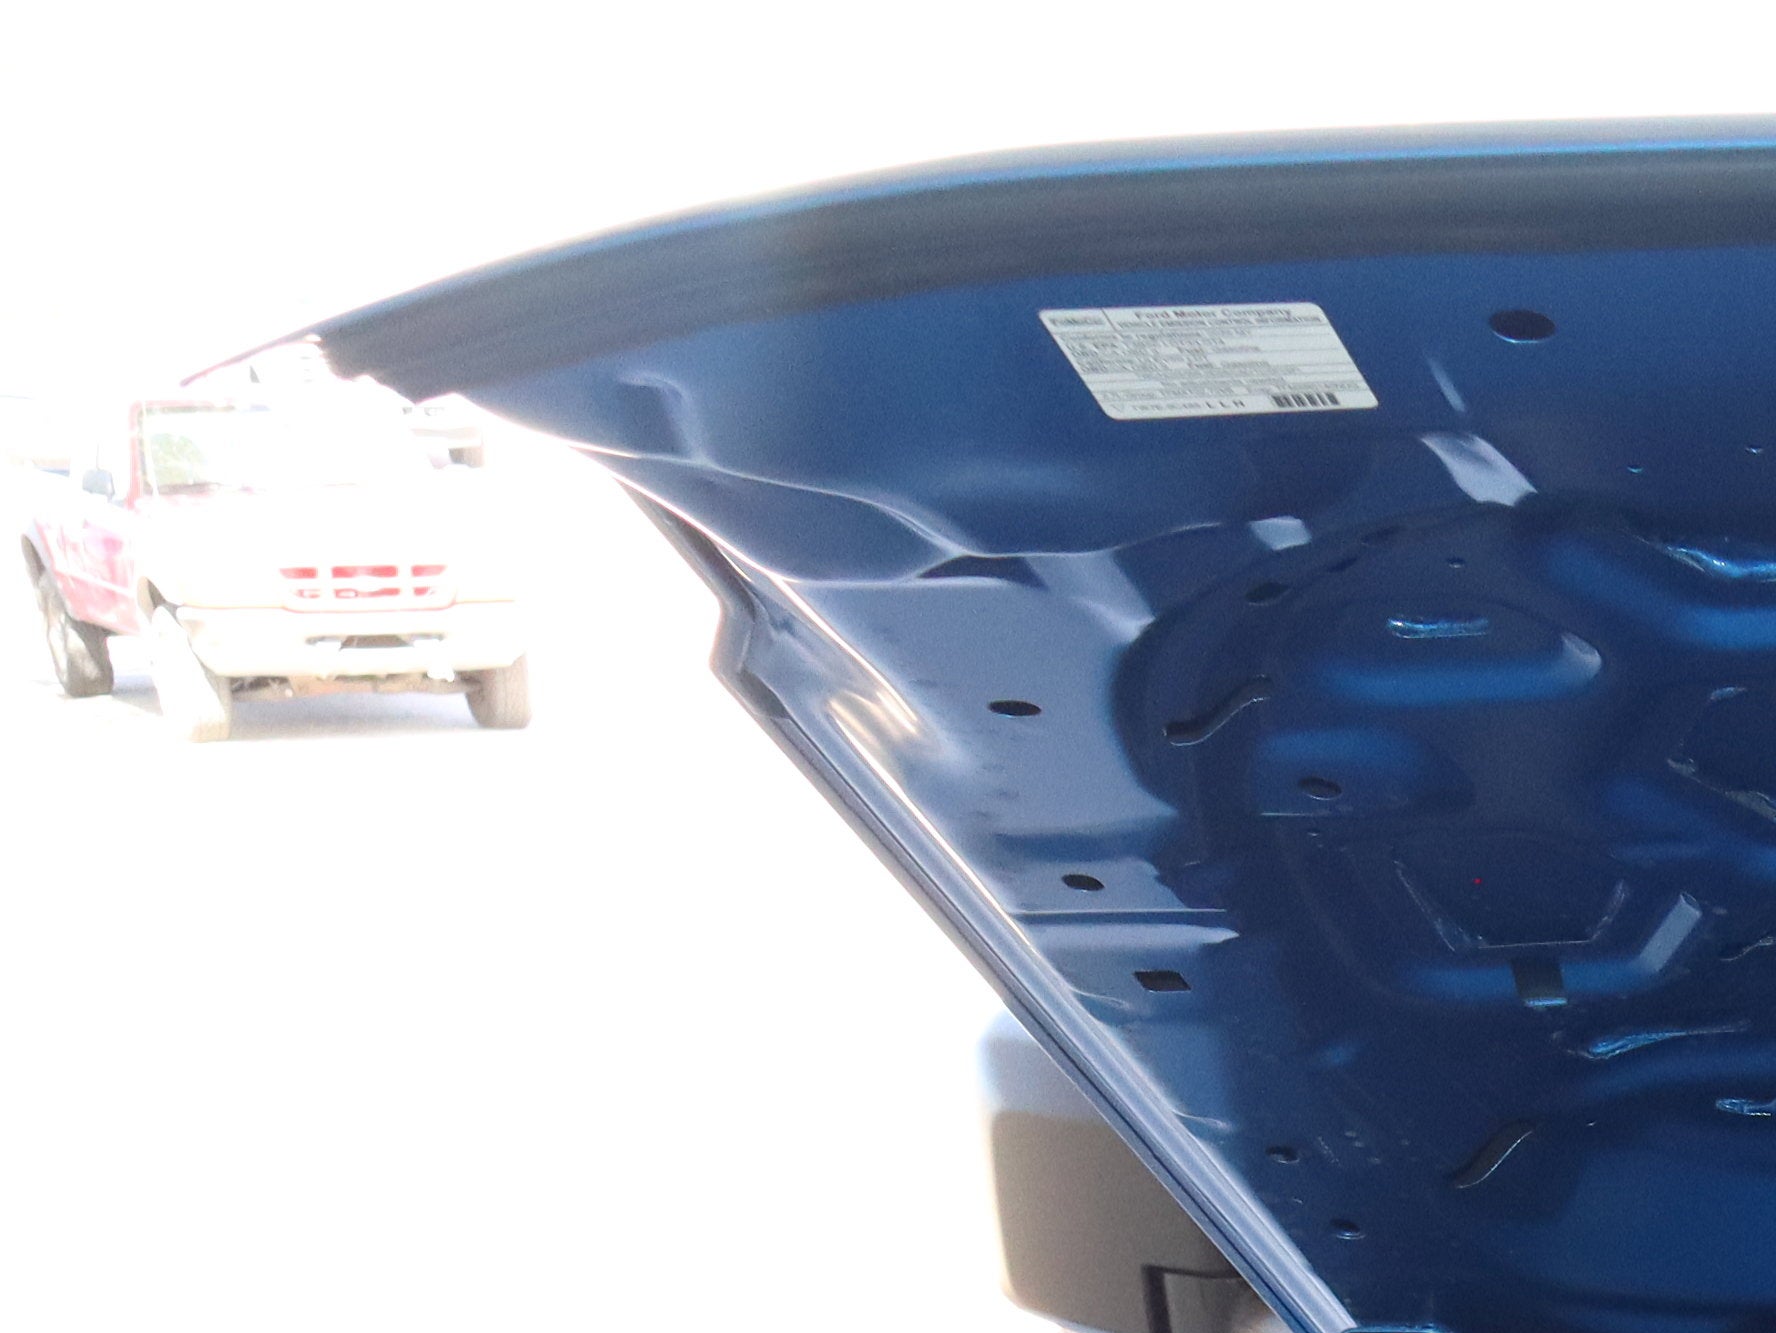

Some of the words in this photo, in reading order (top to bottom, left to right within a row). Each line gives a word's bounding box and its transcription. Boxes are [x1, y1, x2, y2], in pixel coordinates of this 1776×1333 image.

[1133, 311, 1172, 319] Ford
[1172, 309, 1218, 318] Motor
[1219, 307, 1294, 319] Company
